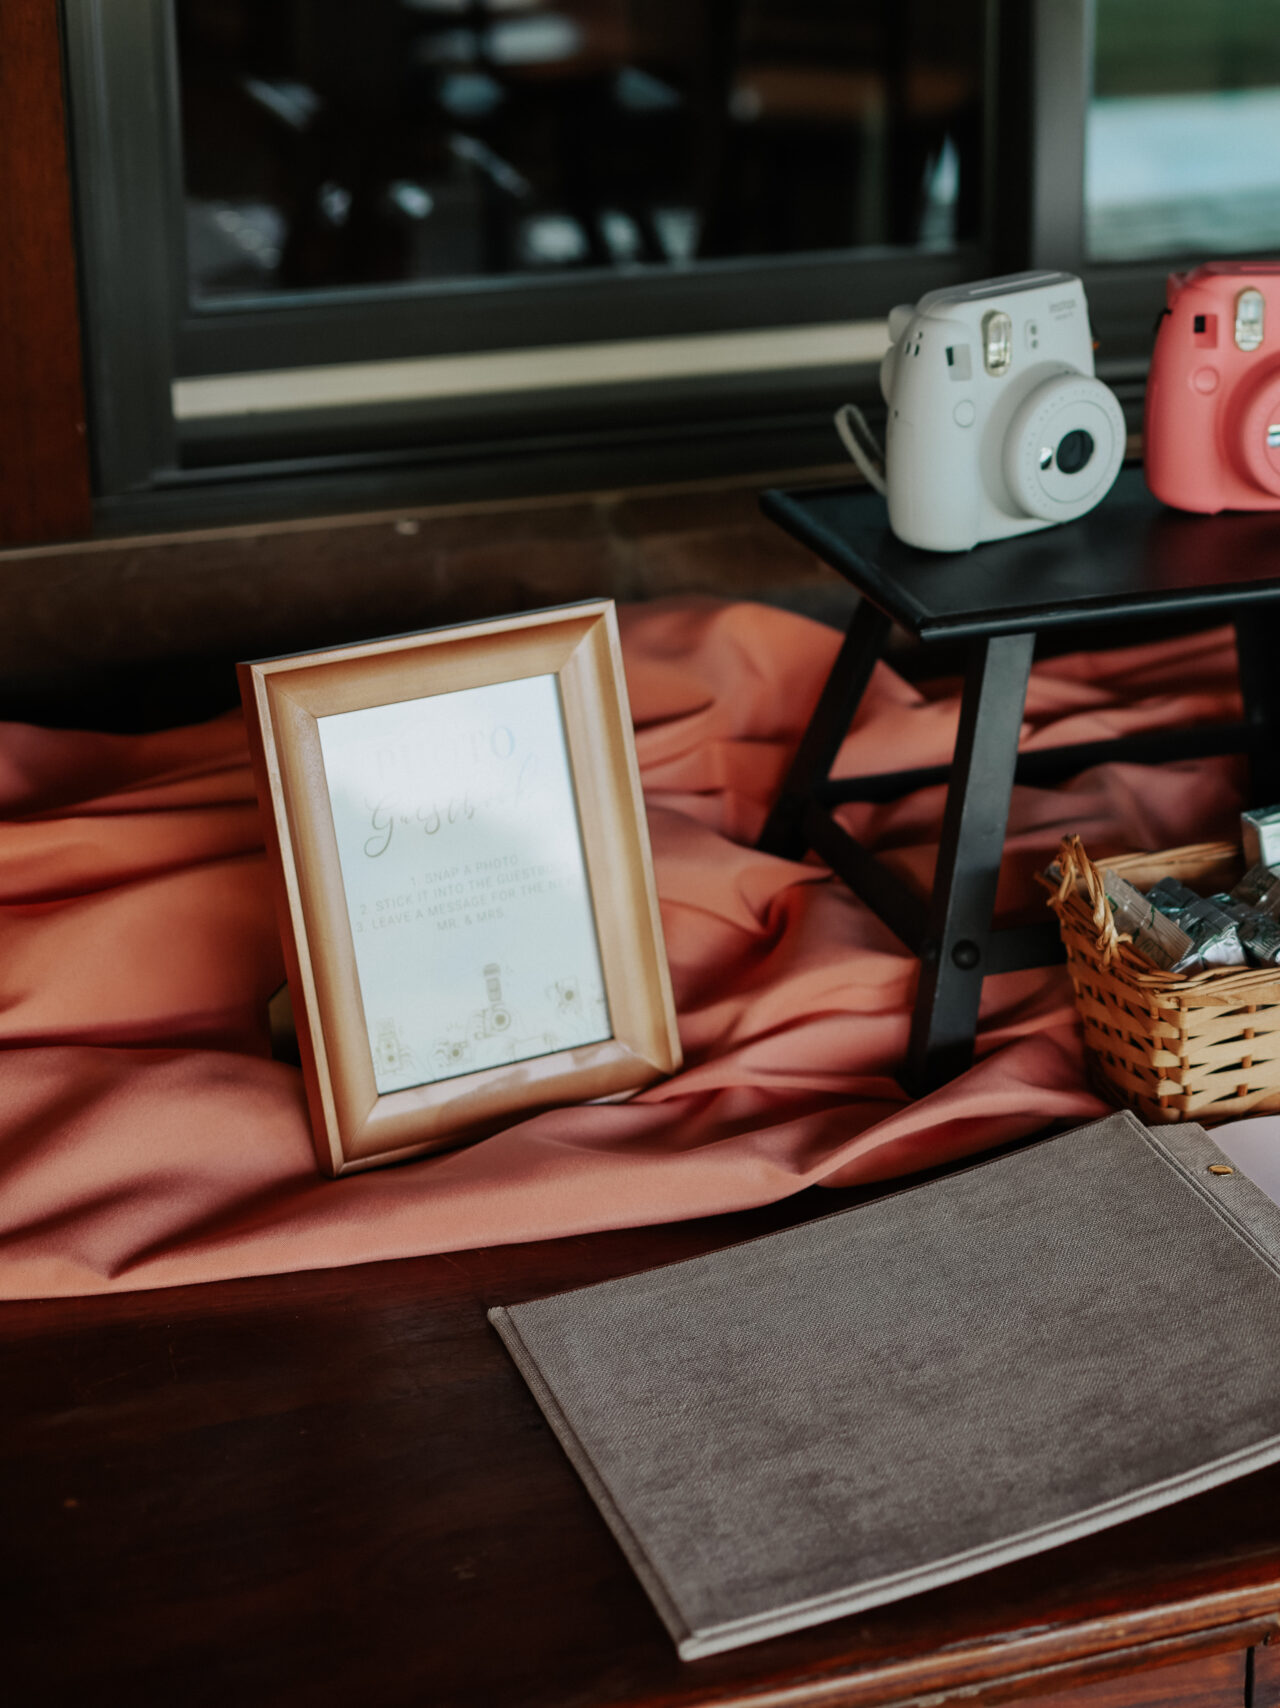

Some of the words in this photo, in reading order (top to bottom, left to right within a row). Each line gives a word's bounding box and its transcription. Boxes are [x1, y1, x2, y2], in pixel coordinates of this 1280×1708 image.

[424, 866, 460, 885] SNAP
[464, 864, 472, 876] A
[475, 853, 519, 872] PHOTO
[371, 911, 411, 930] LEAVE
[415, 909, 424, 920] A
[427, 893, 487, 917] MESSAGE
[490, 887, 516, 902] FOR
[520, 881, 545, 897] THE
[375, 893, 413, 912] STICK
[417, 889, 428, 902] IT
[433, 881, 464, 899] INTO
[468, 875, 493, 890] THE
[464, 914, 473, 926] &
